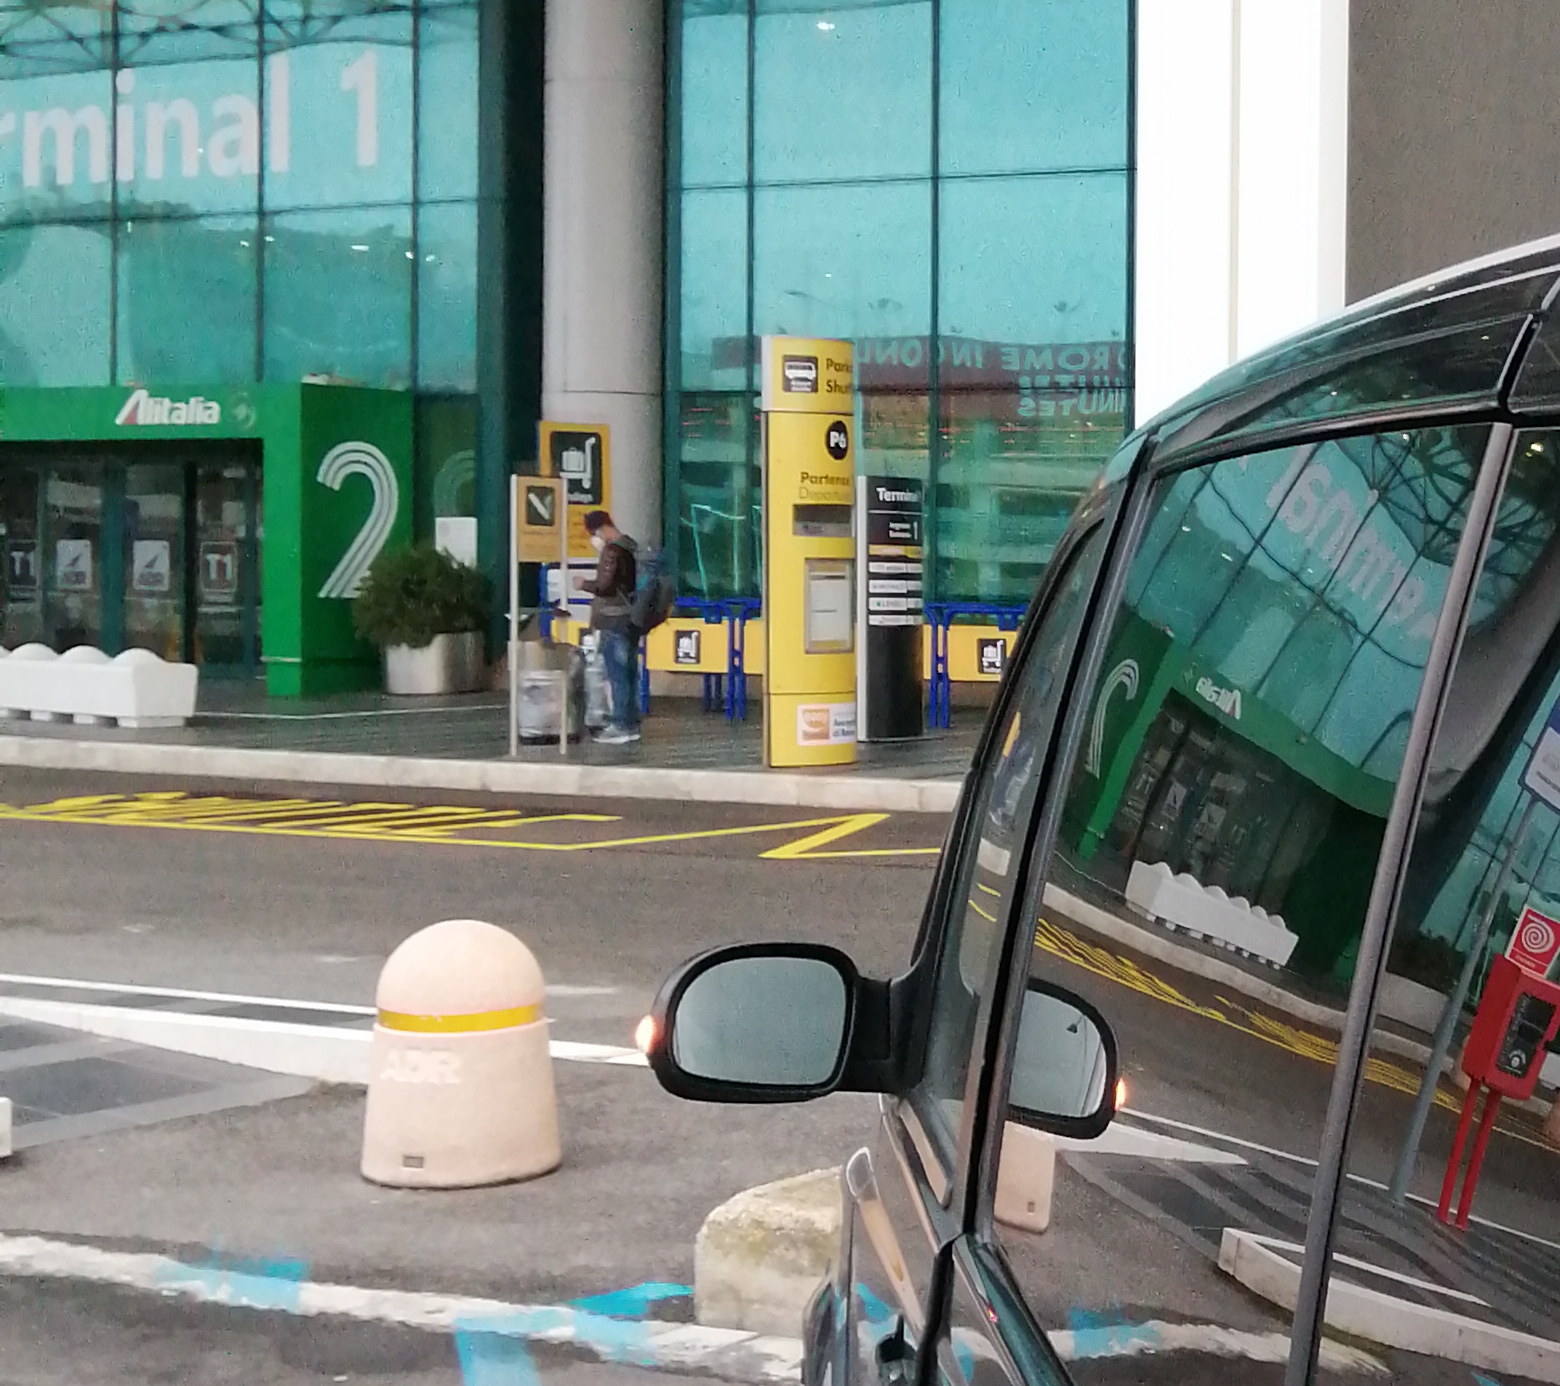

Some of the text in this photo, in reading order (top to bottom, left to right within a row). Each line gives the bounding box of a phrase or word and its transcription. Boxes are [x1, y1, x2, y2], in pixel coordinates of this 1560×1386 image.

[340, 49, 380, 167] 1
[114, 389, 221, 426] Alitalia
[317, 441, 400, 600] 2
